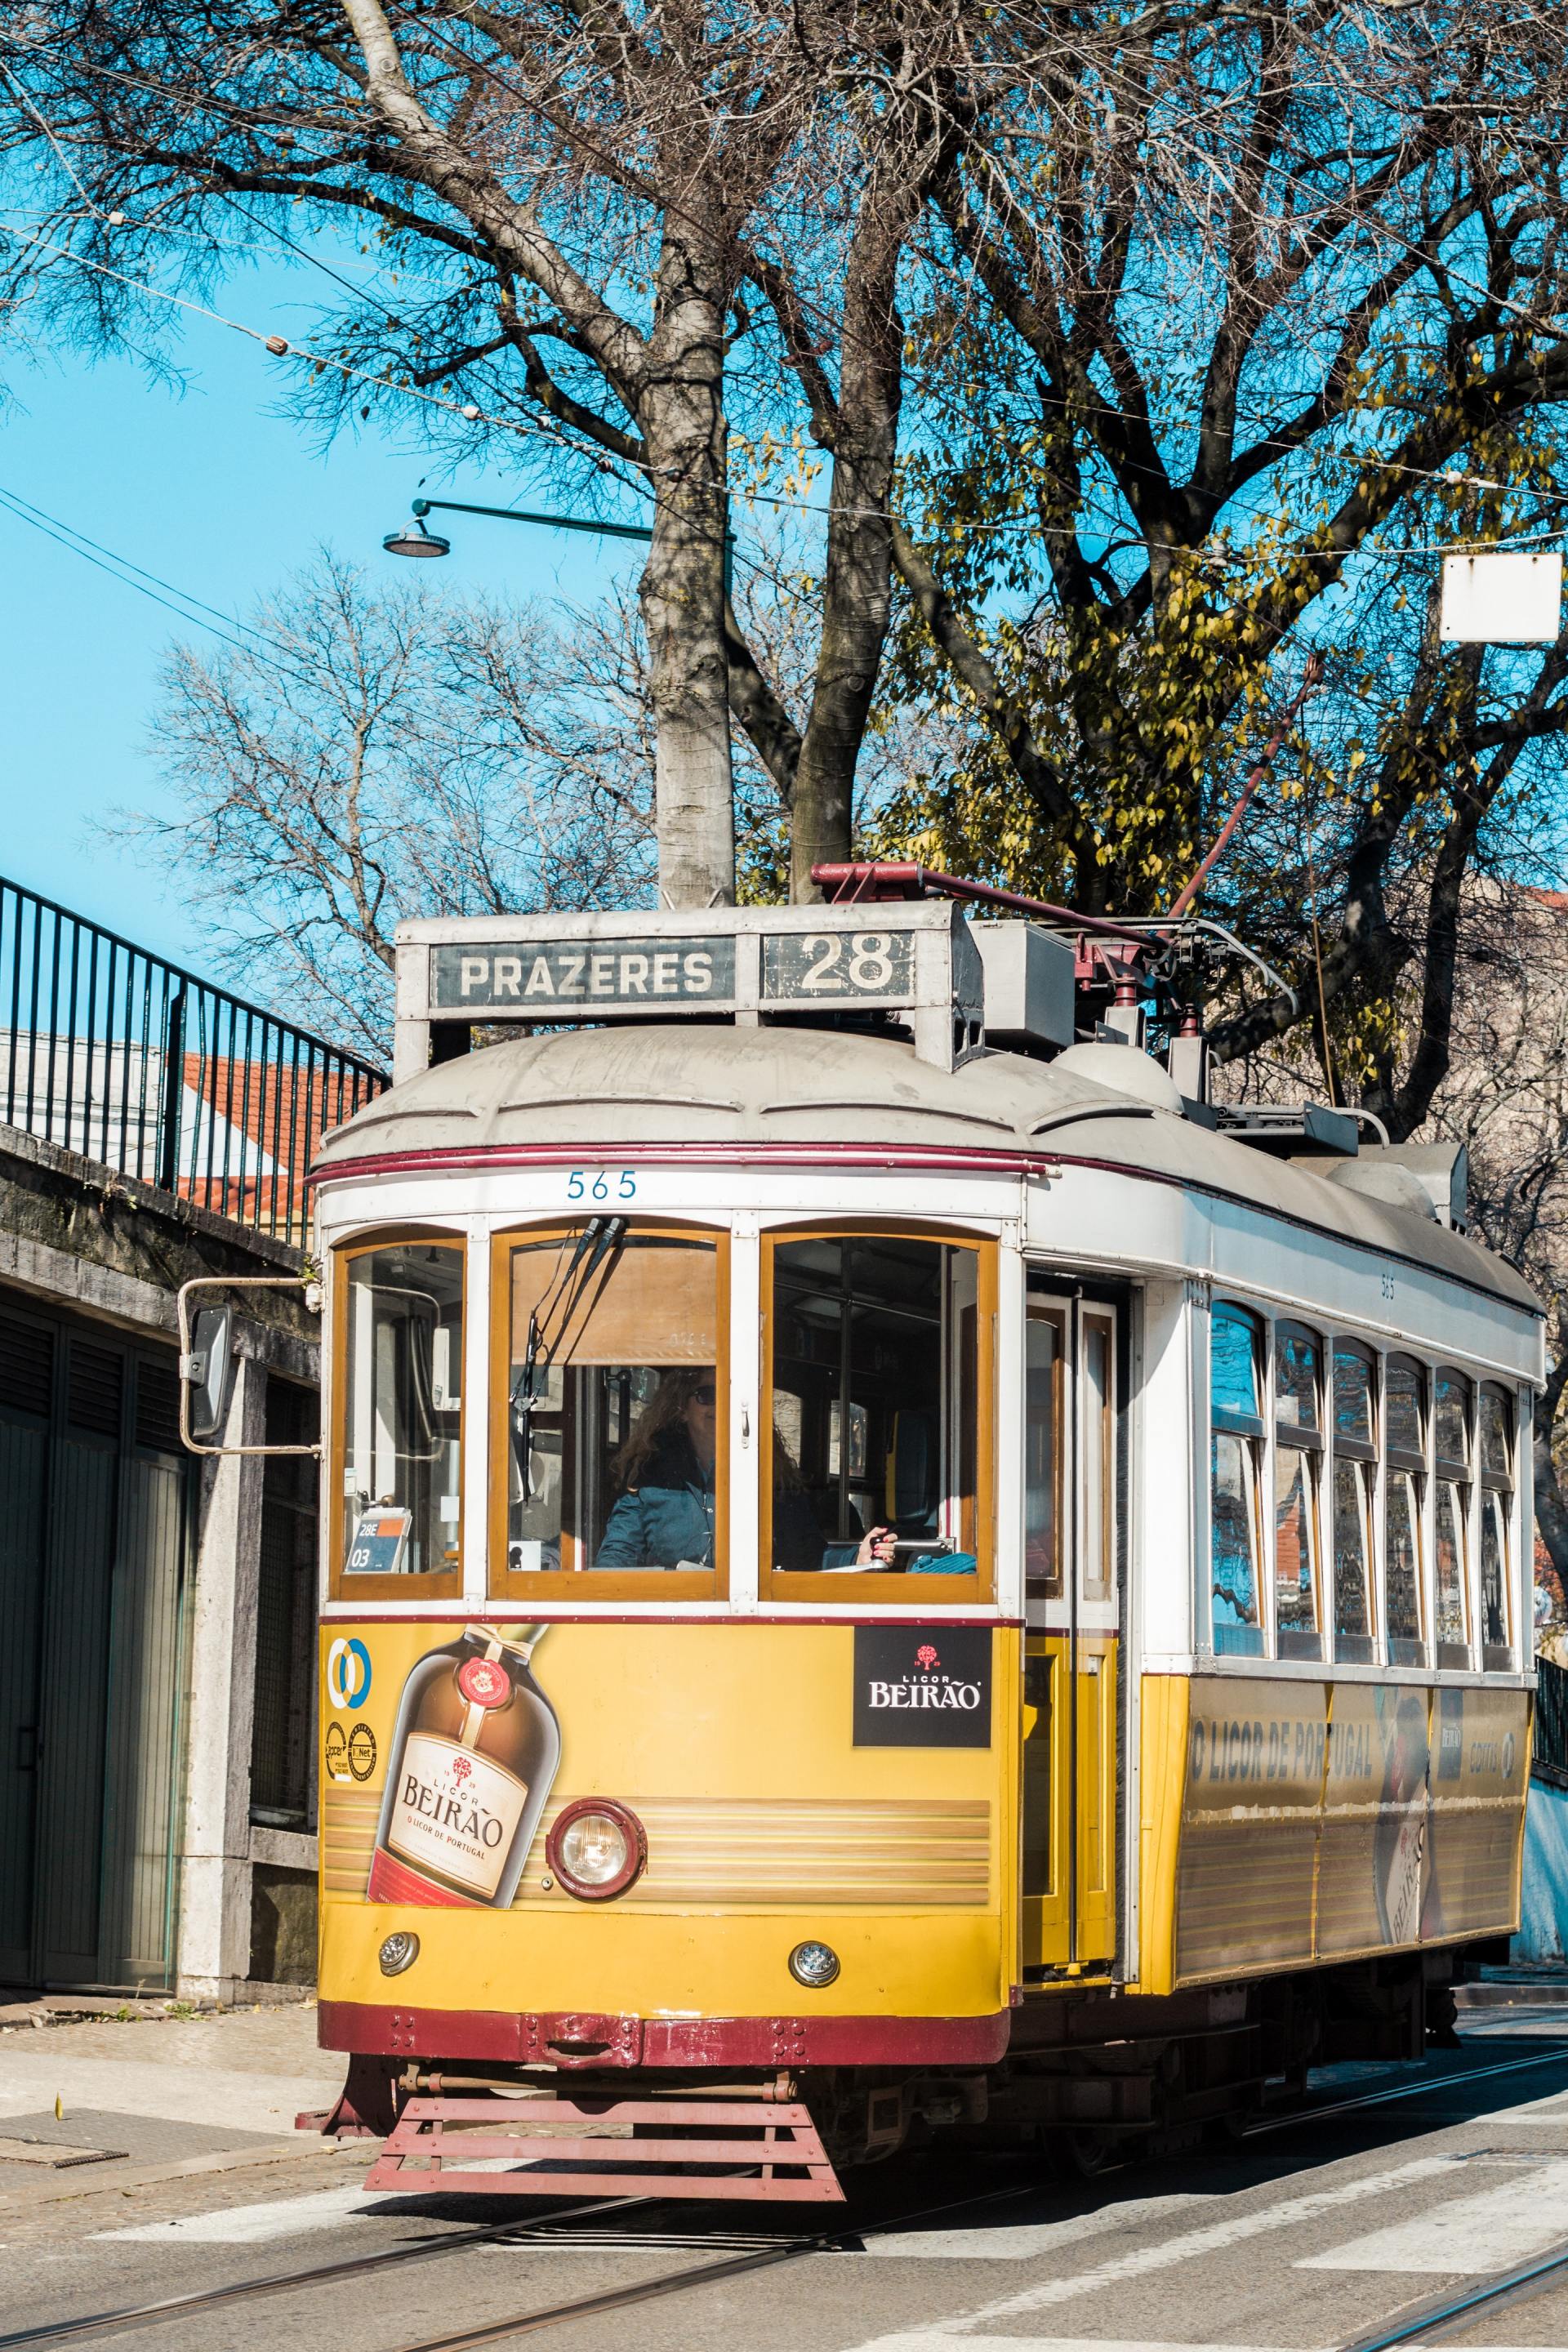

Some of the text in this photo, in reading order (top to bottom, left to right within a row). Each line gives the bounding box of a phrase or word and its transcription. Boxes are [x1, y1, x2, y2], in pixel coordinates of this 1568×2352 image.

[460, 933, 893, 996] PRAZERES 28
[567, 1170, 638, 1200] 565
[1382, 1274, 1395, 1300] 565
[359, 1524, 377, 1536] 28E
[351, 1548, 370, 1567] 03
[902, 1675, 950, 1683] LICOR
[868, 1681, 981, 1709] BEIRÃO
[1209, 1721, 1263, 1782] LICOR
[1267, 1721, 1290, 1778] DE
[434, 1779, 479, 1806] LICOR
[402, 1773, 504, 1848] BEIRÃO
[412, 1816, 434, 1834] LICOR
[434, 1829, 444, 1841] DE
[446, 1836, 485, 1860] PORTUGAL
